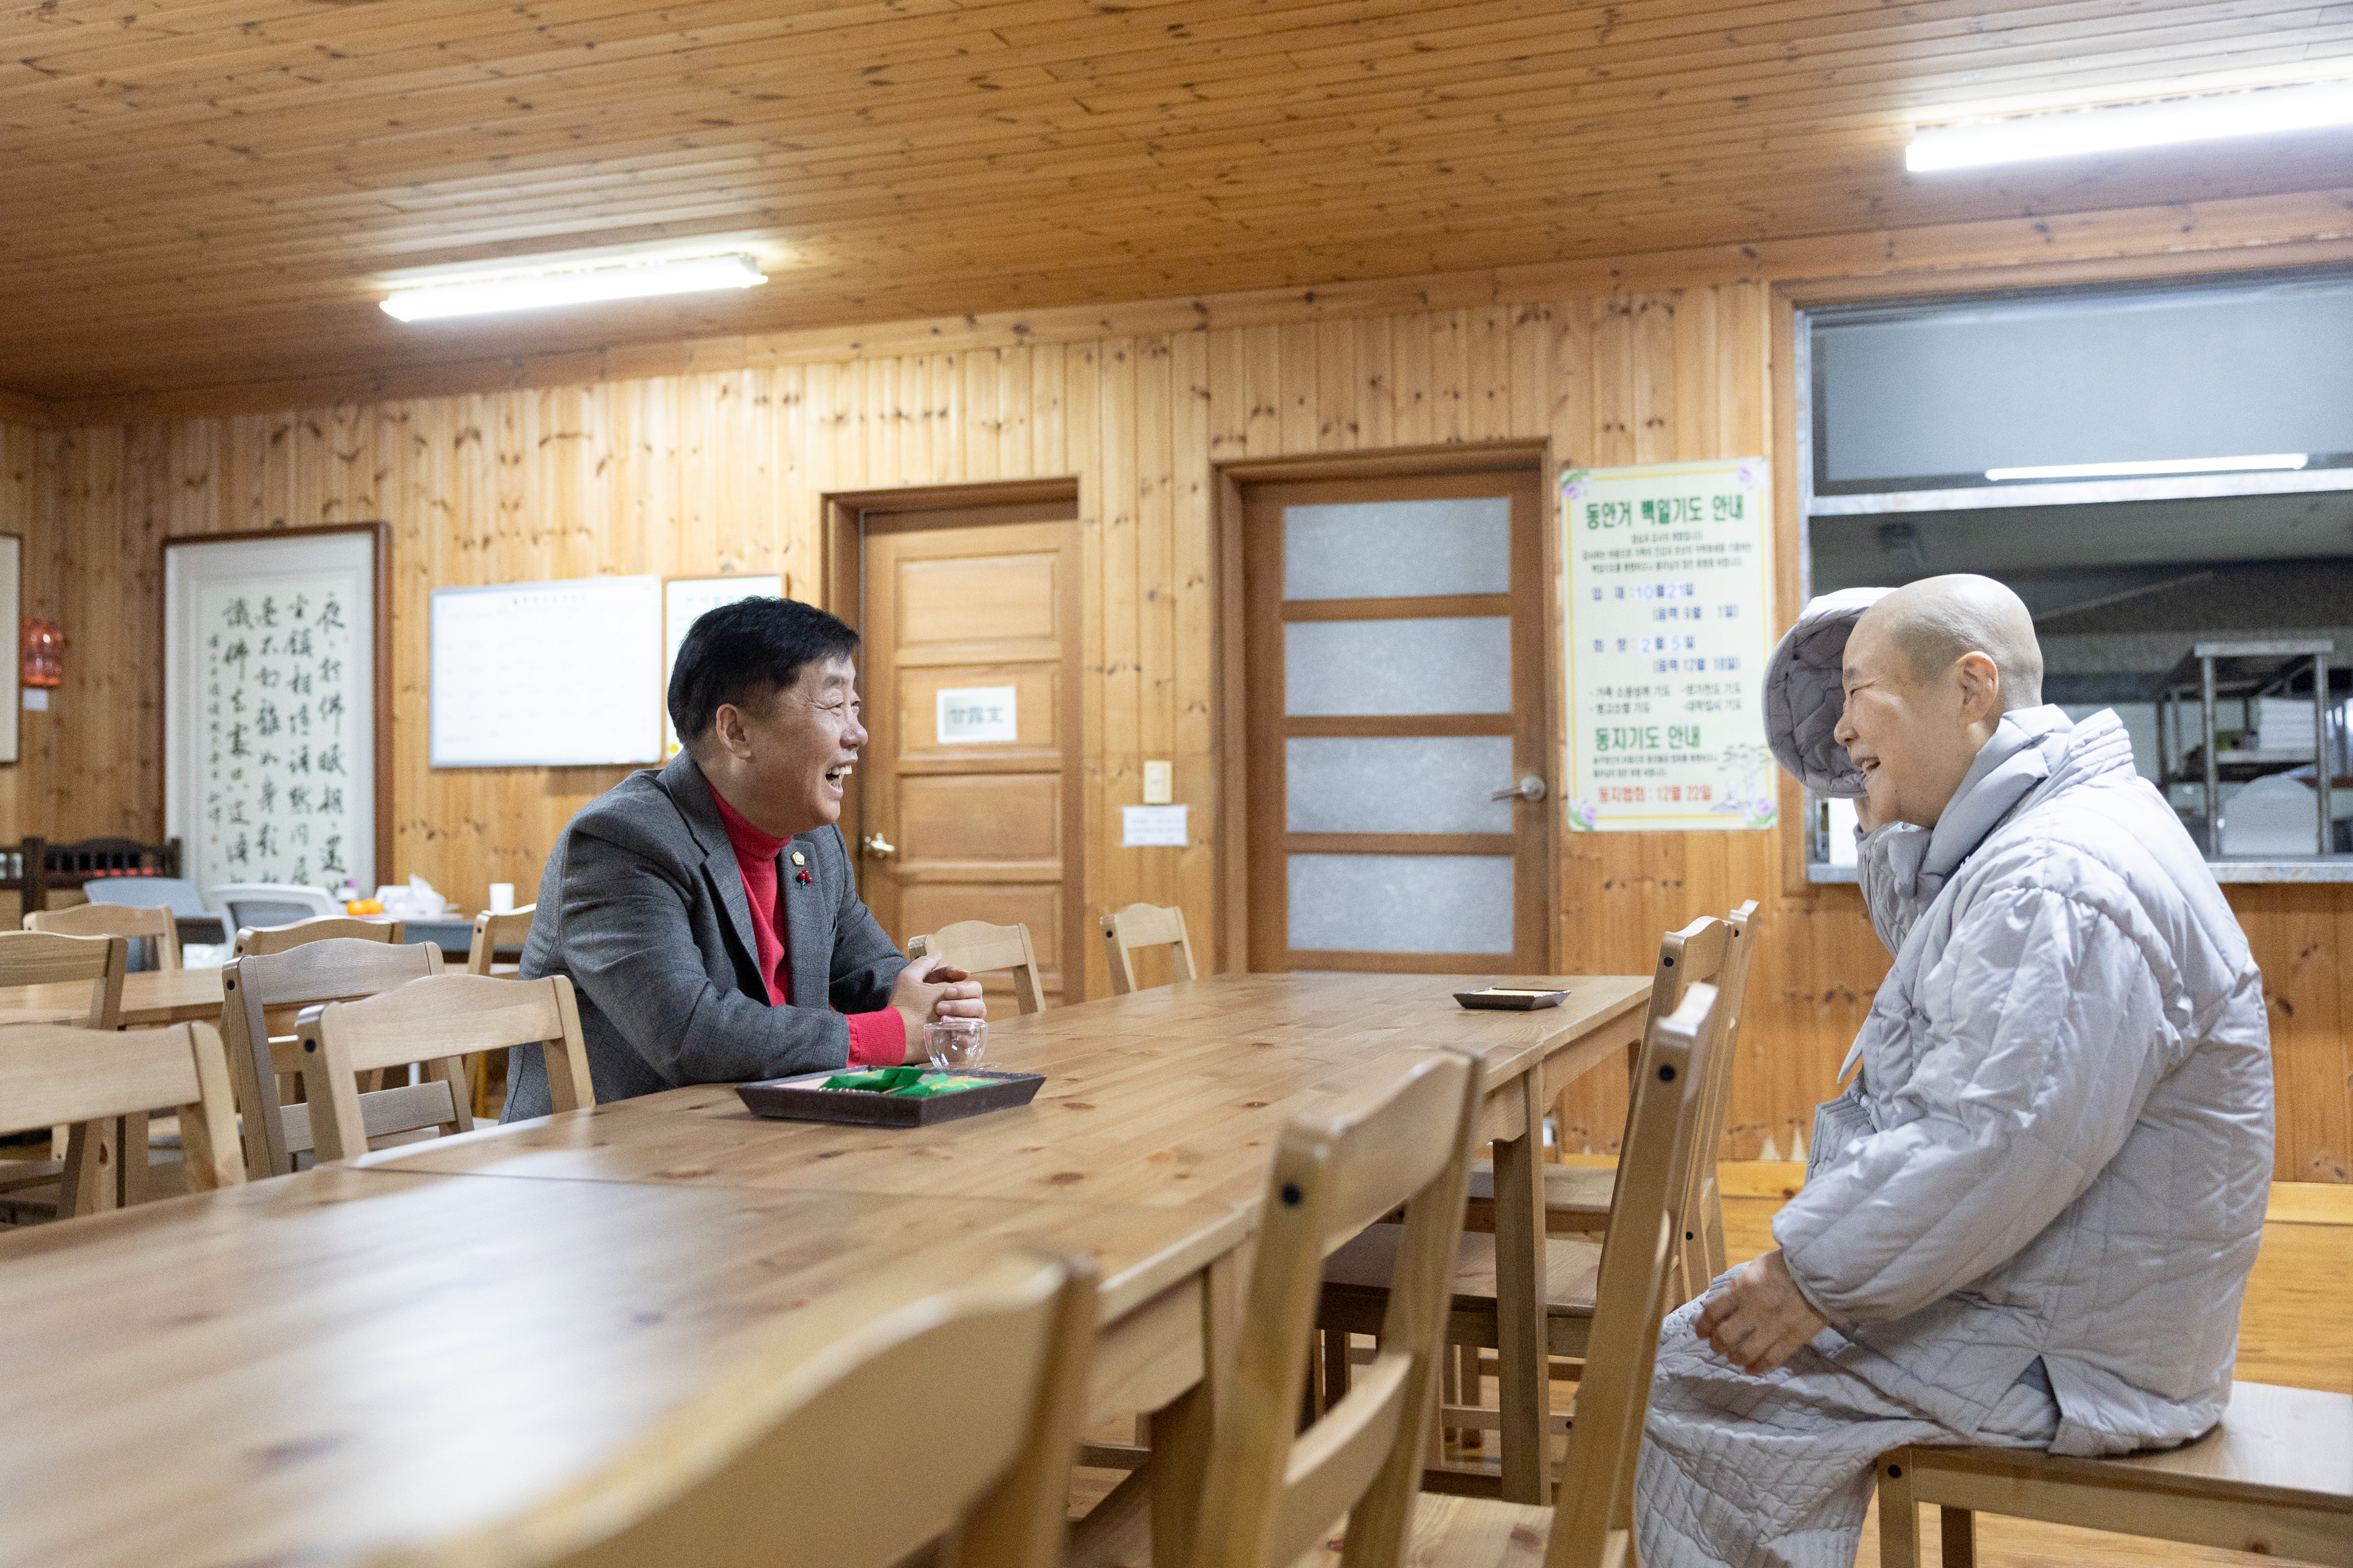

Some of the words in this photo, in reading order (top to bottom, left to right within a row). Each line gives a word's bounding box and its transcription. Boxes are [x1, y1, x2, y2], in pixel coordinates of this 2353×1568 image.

[1587, 502, 1632, 530] 동안거
[1641, 497, 1703, 526] 백일기도
[1712, 493, 1744, 522] 안내
[1595, 726, 1660, 751] 동지기도
[1667, 724, 1700, 749] 안내
